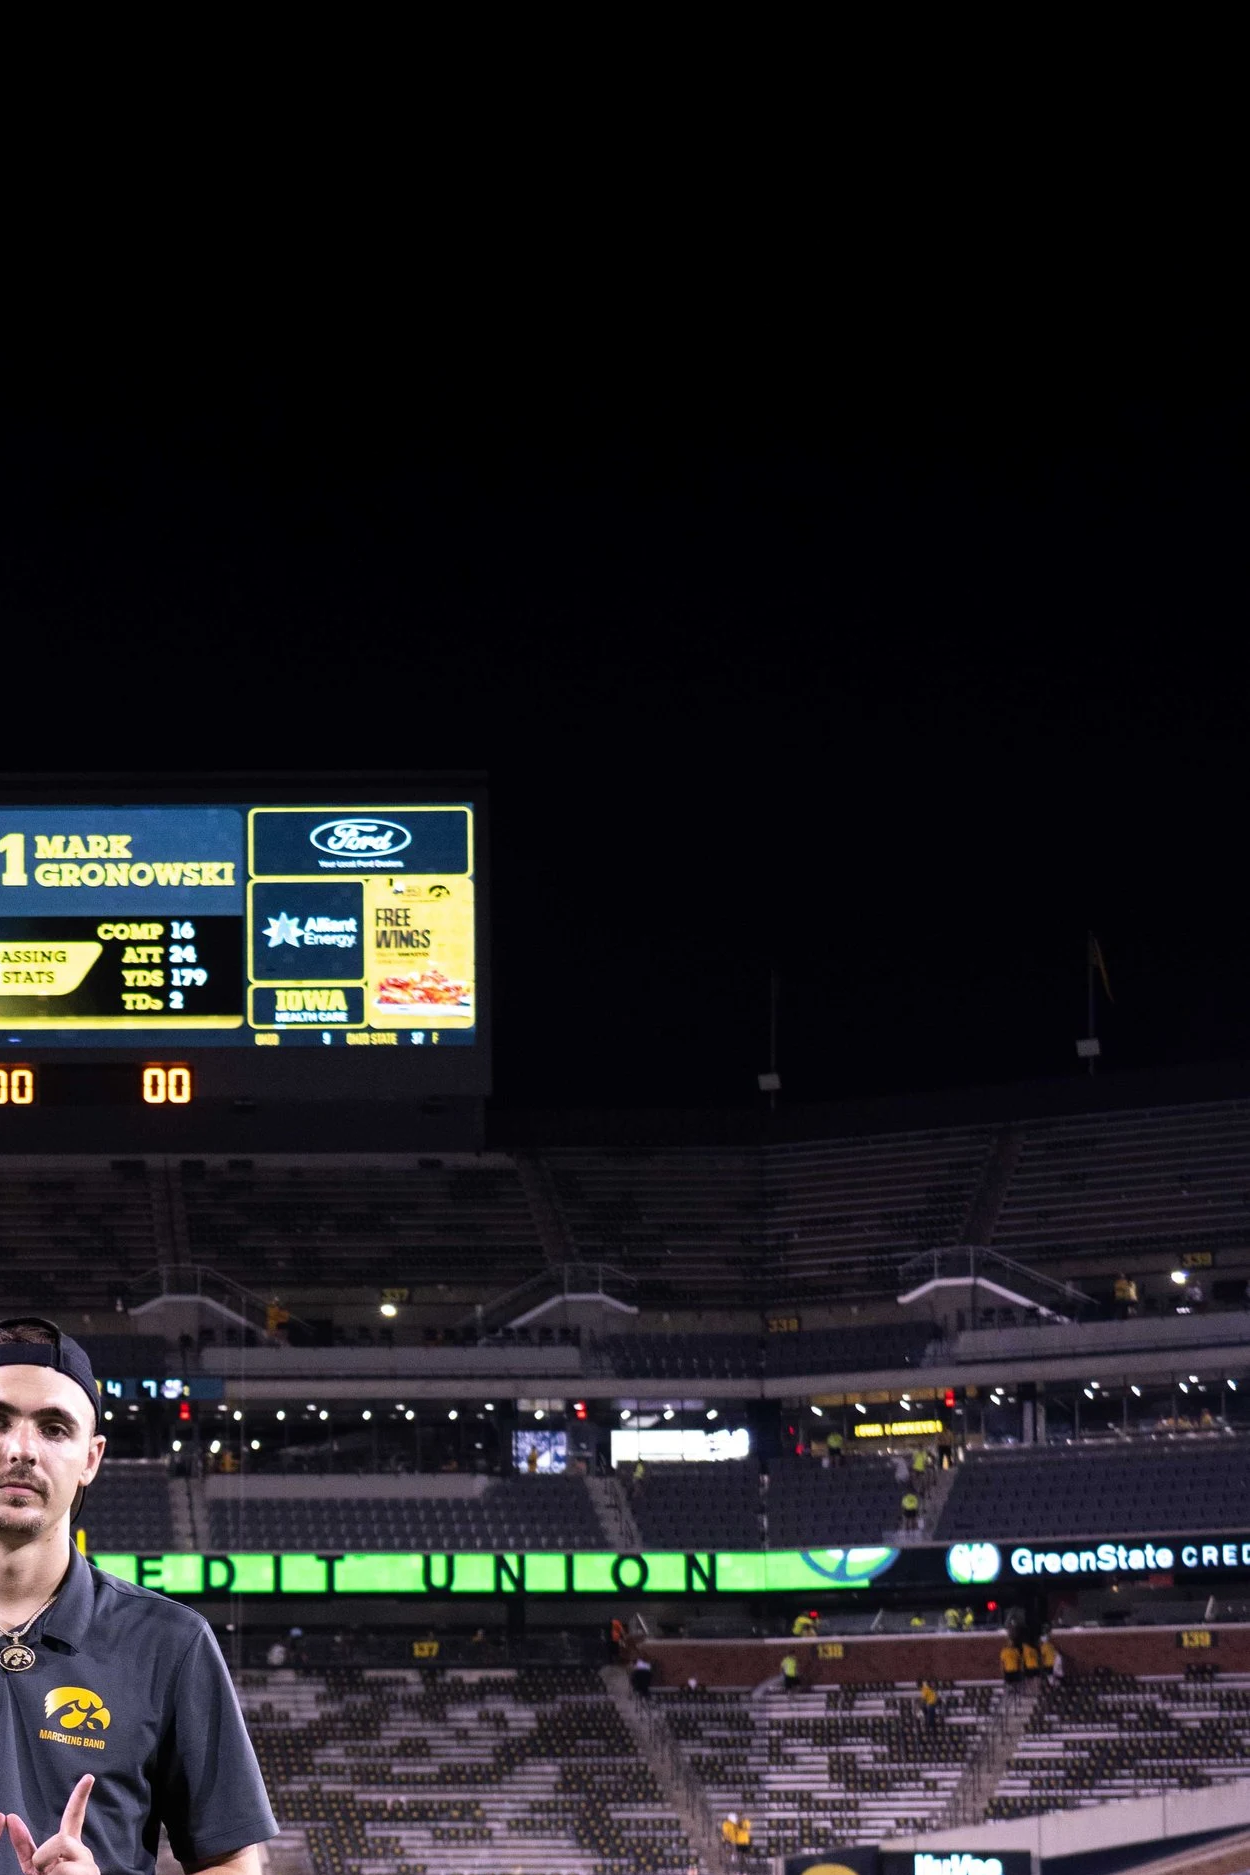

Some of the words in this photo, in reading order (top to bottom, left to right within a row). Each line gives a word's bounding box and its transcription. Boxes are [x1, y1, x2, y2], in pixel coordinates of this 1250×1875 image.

[34, 834, 133, 859] MARK
[327, 824, 394, 850] Ford
[34, 861, 236, 887] GRONOWSKI
[304, 917, 357, 932] Alliant
[376, 908, 411, 927] FREE
[96, 922, 165, 941] COMP
[170, 920, 196, 940] 16
[376, 929, 431, 949] WINGS
[121, 946, 165, 964] ATT
[168, 944, 198, 964] 24
[3, 971, 55, 984] STATS
[121, 969, 165, 987] YDS
[170, 967, 208, 987] 179
[121, 992, 164, 1011] TDs
[168, 990, 185, 1011] 2
[275, 990, 348, 1011] IOWA
[142, 1067, 192, 1104] 00
[1010, 1544, 1174, 1575] GreenState
[100, 1554, 345, 1594] EDIT
[422, 1554, 717, 1593] UNION
[39, 1729, 82, 1746] MARCHING
[83, 1738, 106, 1750] BAND
